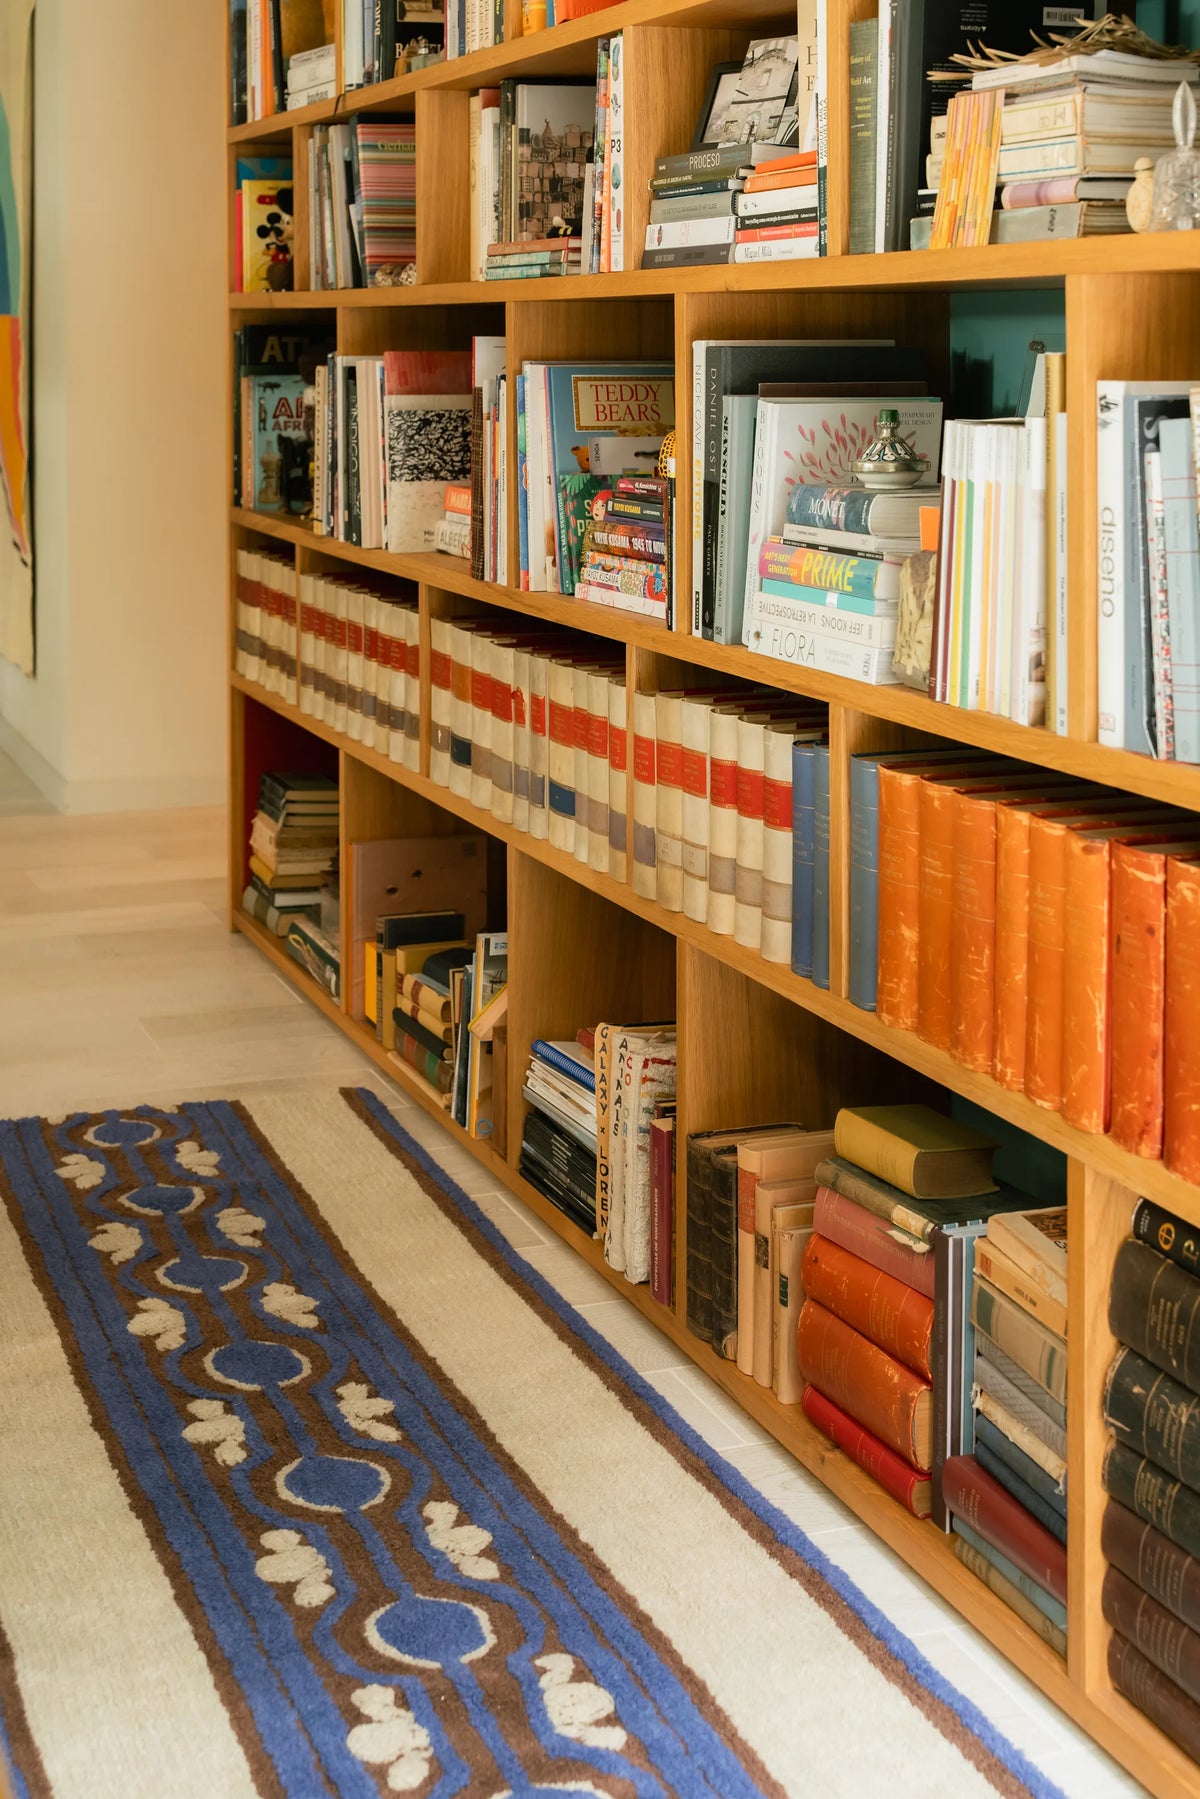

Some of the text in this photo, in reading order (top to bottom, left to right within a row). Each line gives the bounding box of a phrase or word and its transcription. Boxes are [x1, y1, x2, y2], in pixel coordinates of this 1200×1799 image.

[863, 75, 872, 84] Art
[611, 139, 622, 153] P3
[689, 153, 721, 170] PROCESO
[590, 383, 662, 402] TEDDY
[594, 403, 662, 422] BEARS
[709, 367, 718, 476] DANIEL OST
[720, 415, 729, 519] SEAN SCULLY
[753, 410, 768, 513] BLOOMS
[694, 459, 702, 541] EPITOME
[808, 498, 847, 519] MONET
[599, 571, 619, 584] KUSAMA
[767, 564, 798, 577] GENERATION
[801, 552, 858, 592] PRIME
[807, 612, 816, 624] LA
[820, 614, 847, 632] KOONS
[848, 622, 864, 635] JEFF
[772, 627, 816, 666] FLORA
[599, 1026, 609, 1116] GALAXY
[612, 1037, 628, 1136] ANIMALS
